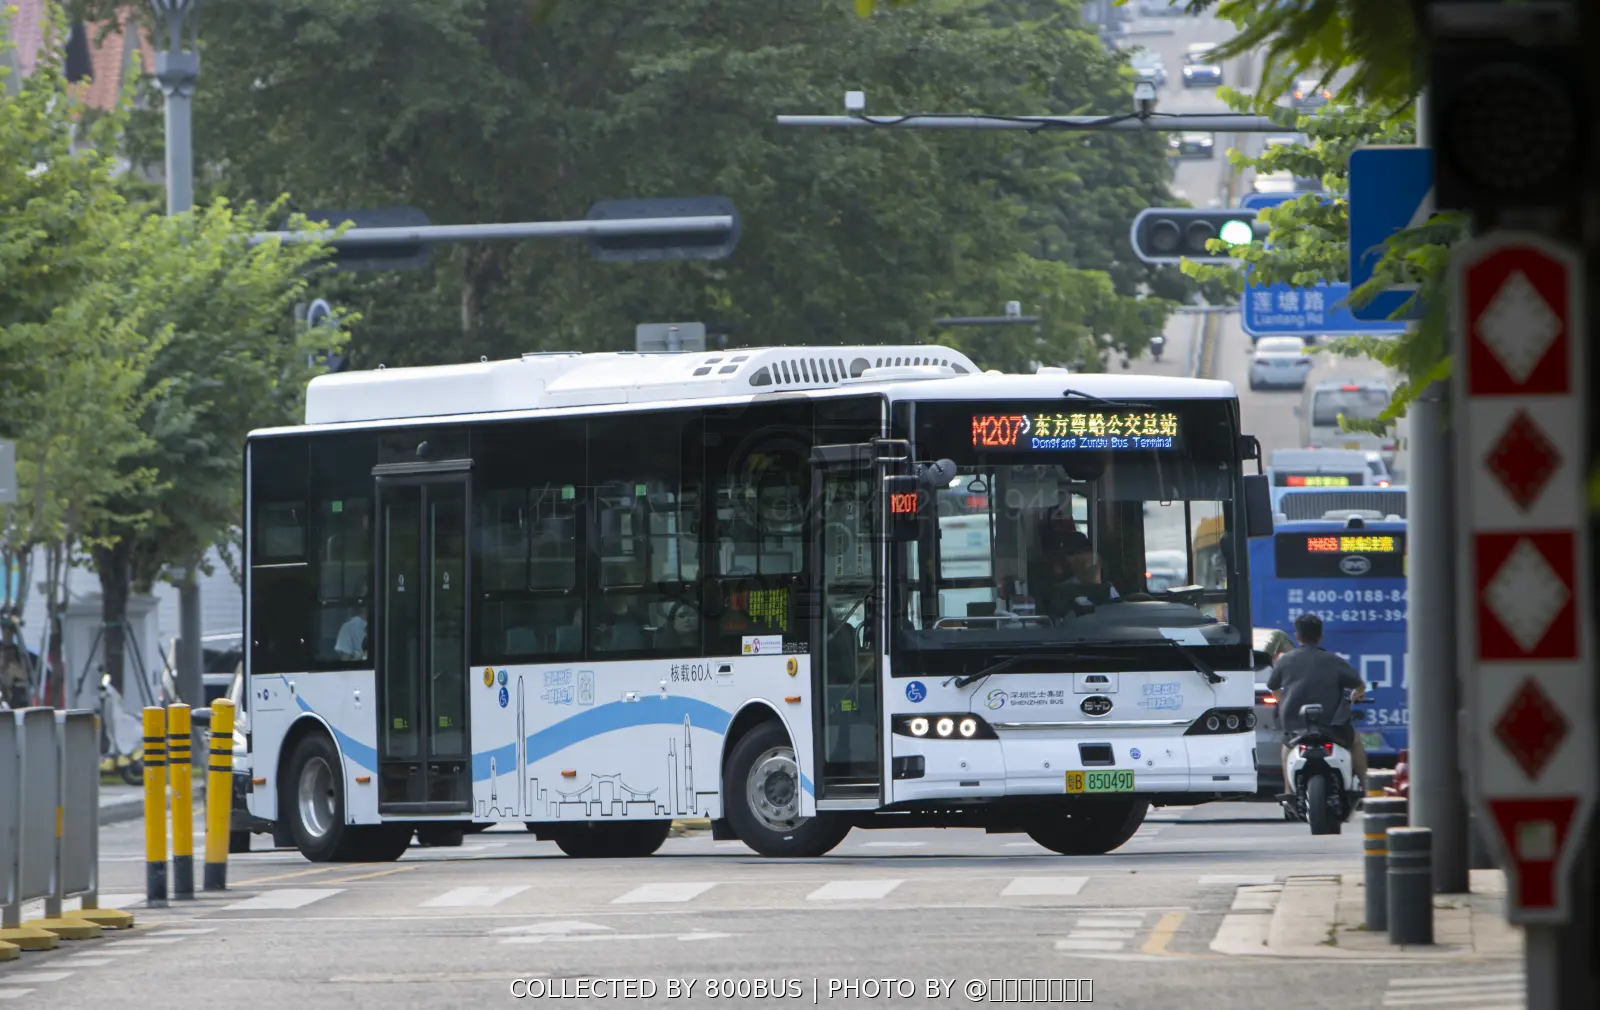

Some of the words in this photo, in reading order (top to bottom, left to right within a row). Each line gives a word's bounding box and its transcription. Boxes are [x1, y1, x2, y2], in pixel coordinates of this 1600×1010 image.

[1252, 290, 1324, 312] 莲塘路
[972, 415, 1022, 446] M207
[1033, 413, 1178, 437] 东方尊峪公交总站
[1032, 437, 1076, 449] Dongfang
[1111, 437, 1129, 448] Bus
[1132, 436, 1172, 448] Terminal
[670, 663, 713, 683] 核载60人
[1009, 690, 1064, 699] 深圳巴士集团
[1084, 701, 1111, 711] BYD
[1089, 773, 1133, 789] 85049D
